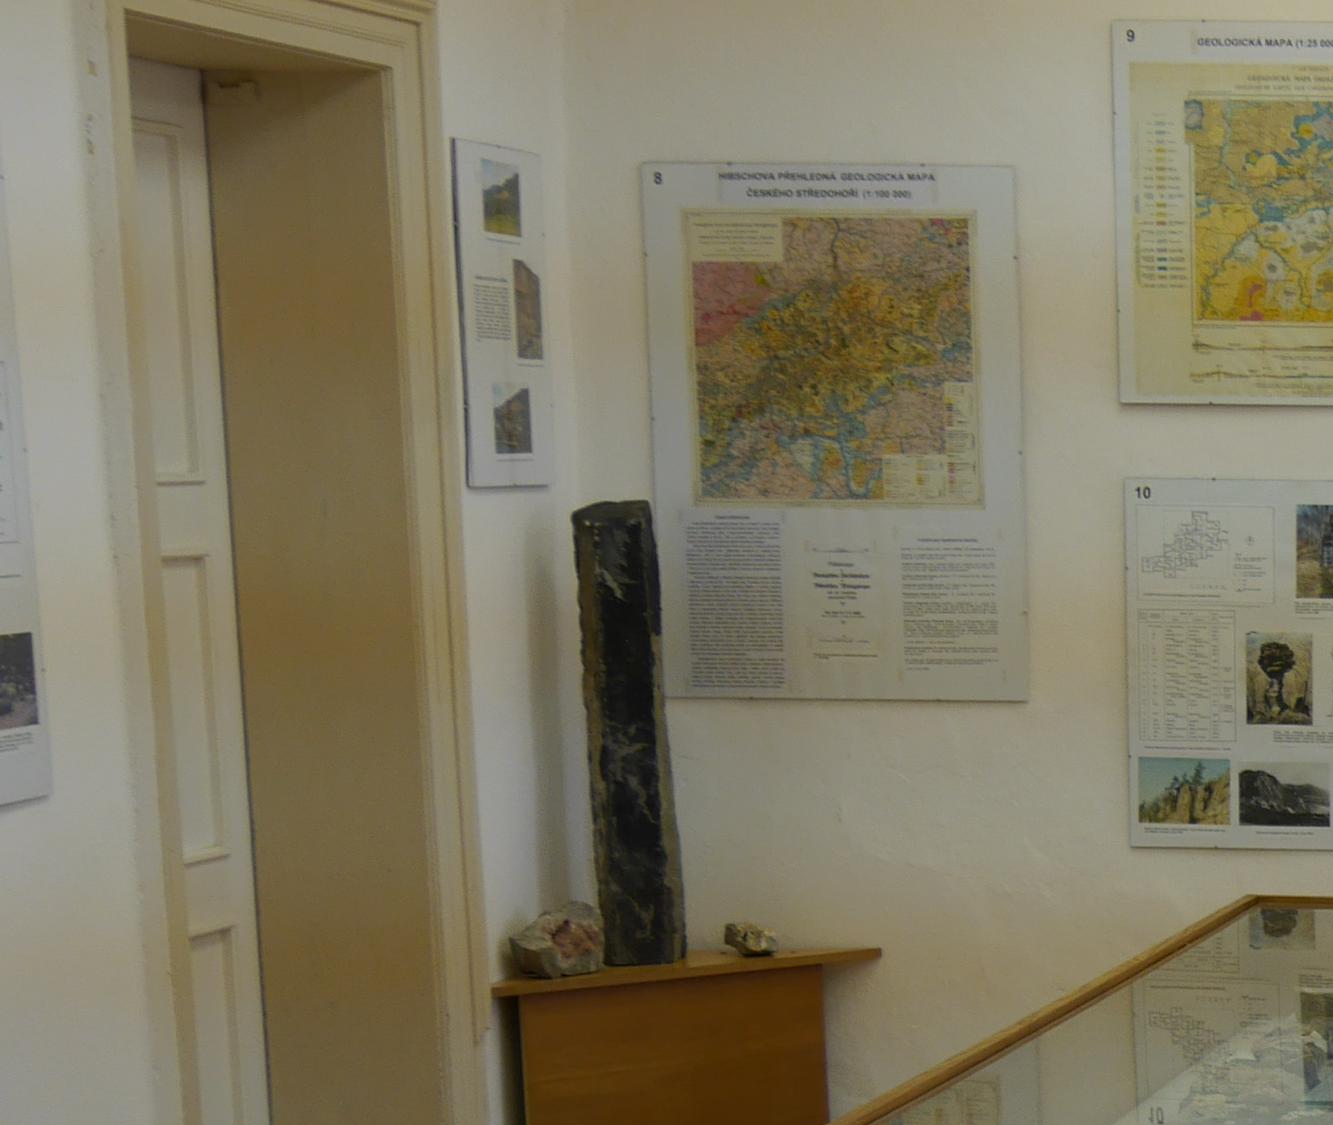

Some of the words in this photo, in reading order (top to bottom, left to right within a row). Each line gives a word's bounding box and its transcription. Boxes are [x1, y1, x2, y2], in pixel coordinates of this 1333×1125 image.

[1126, 29, 1135, 42] 9
[1197, 37, 1262, 48] GEOLOGICKÁ
[1265, 39, 1293, 48] MAPA
[653, 171, 663, 185] 8
[1134, 487, 1151, 500] 10
